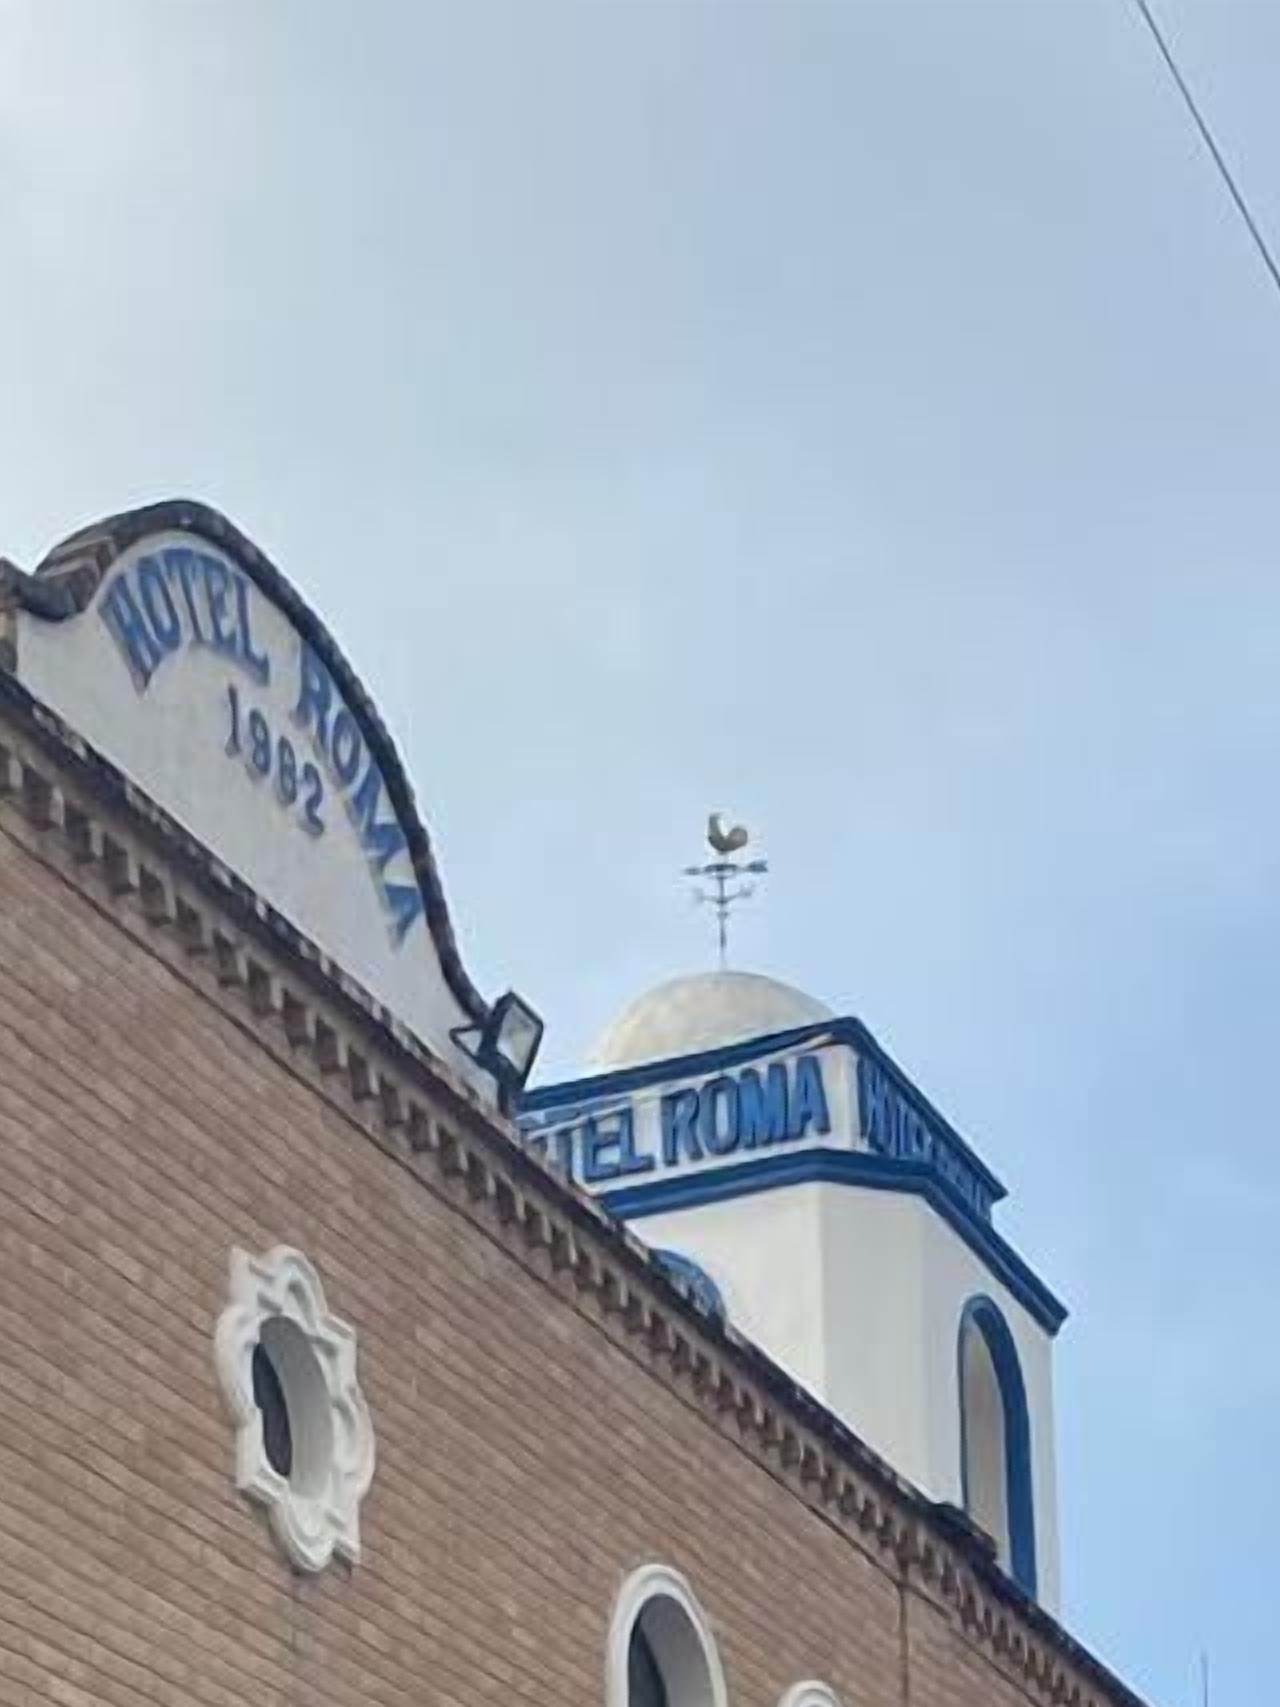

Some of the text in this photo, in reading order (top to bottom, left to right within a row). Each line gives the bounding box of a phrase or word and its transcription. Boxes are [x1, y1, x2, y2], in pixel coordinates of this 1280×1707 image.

[97, 546, 427, 950] HOTEL ROMA
[663, 1054, 832, 1167] ROMA
